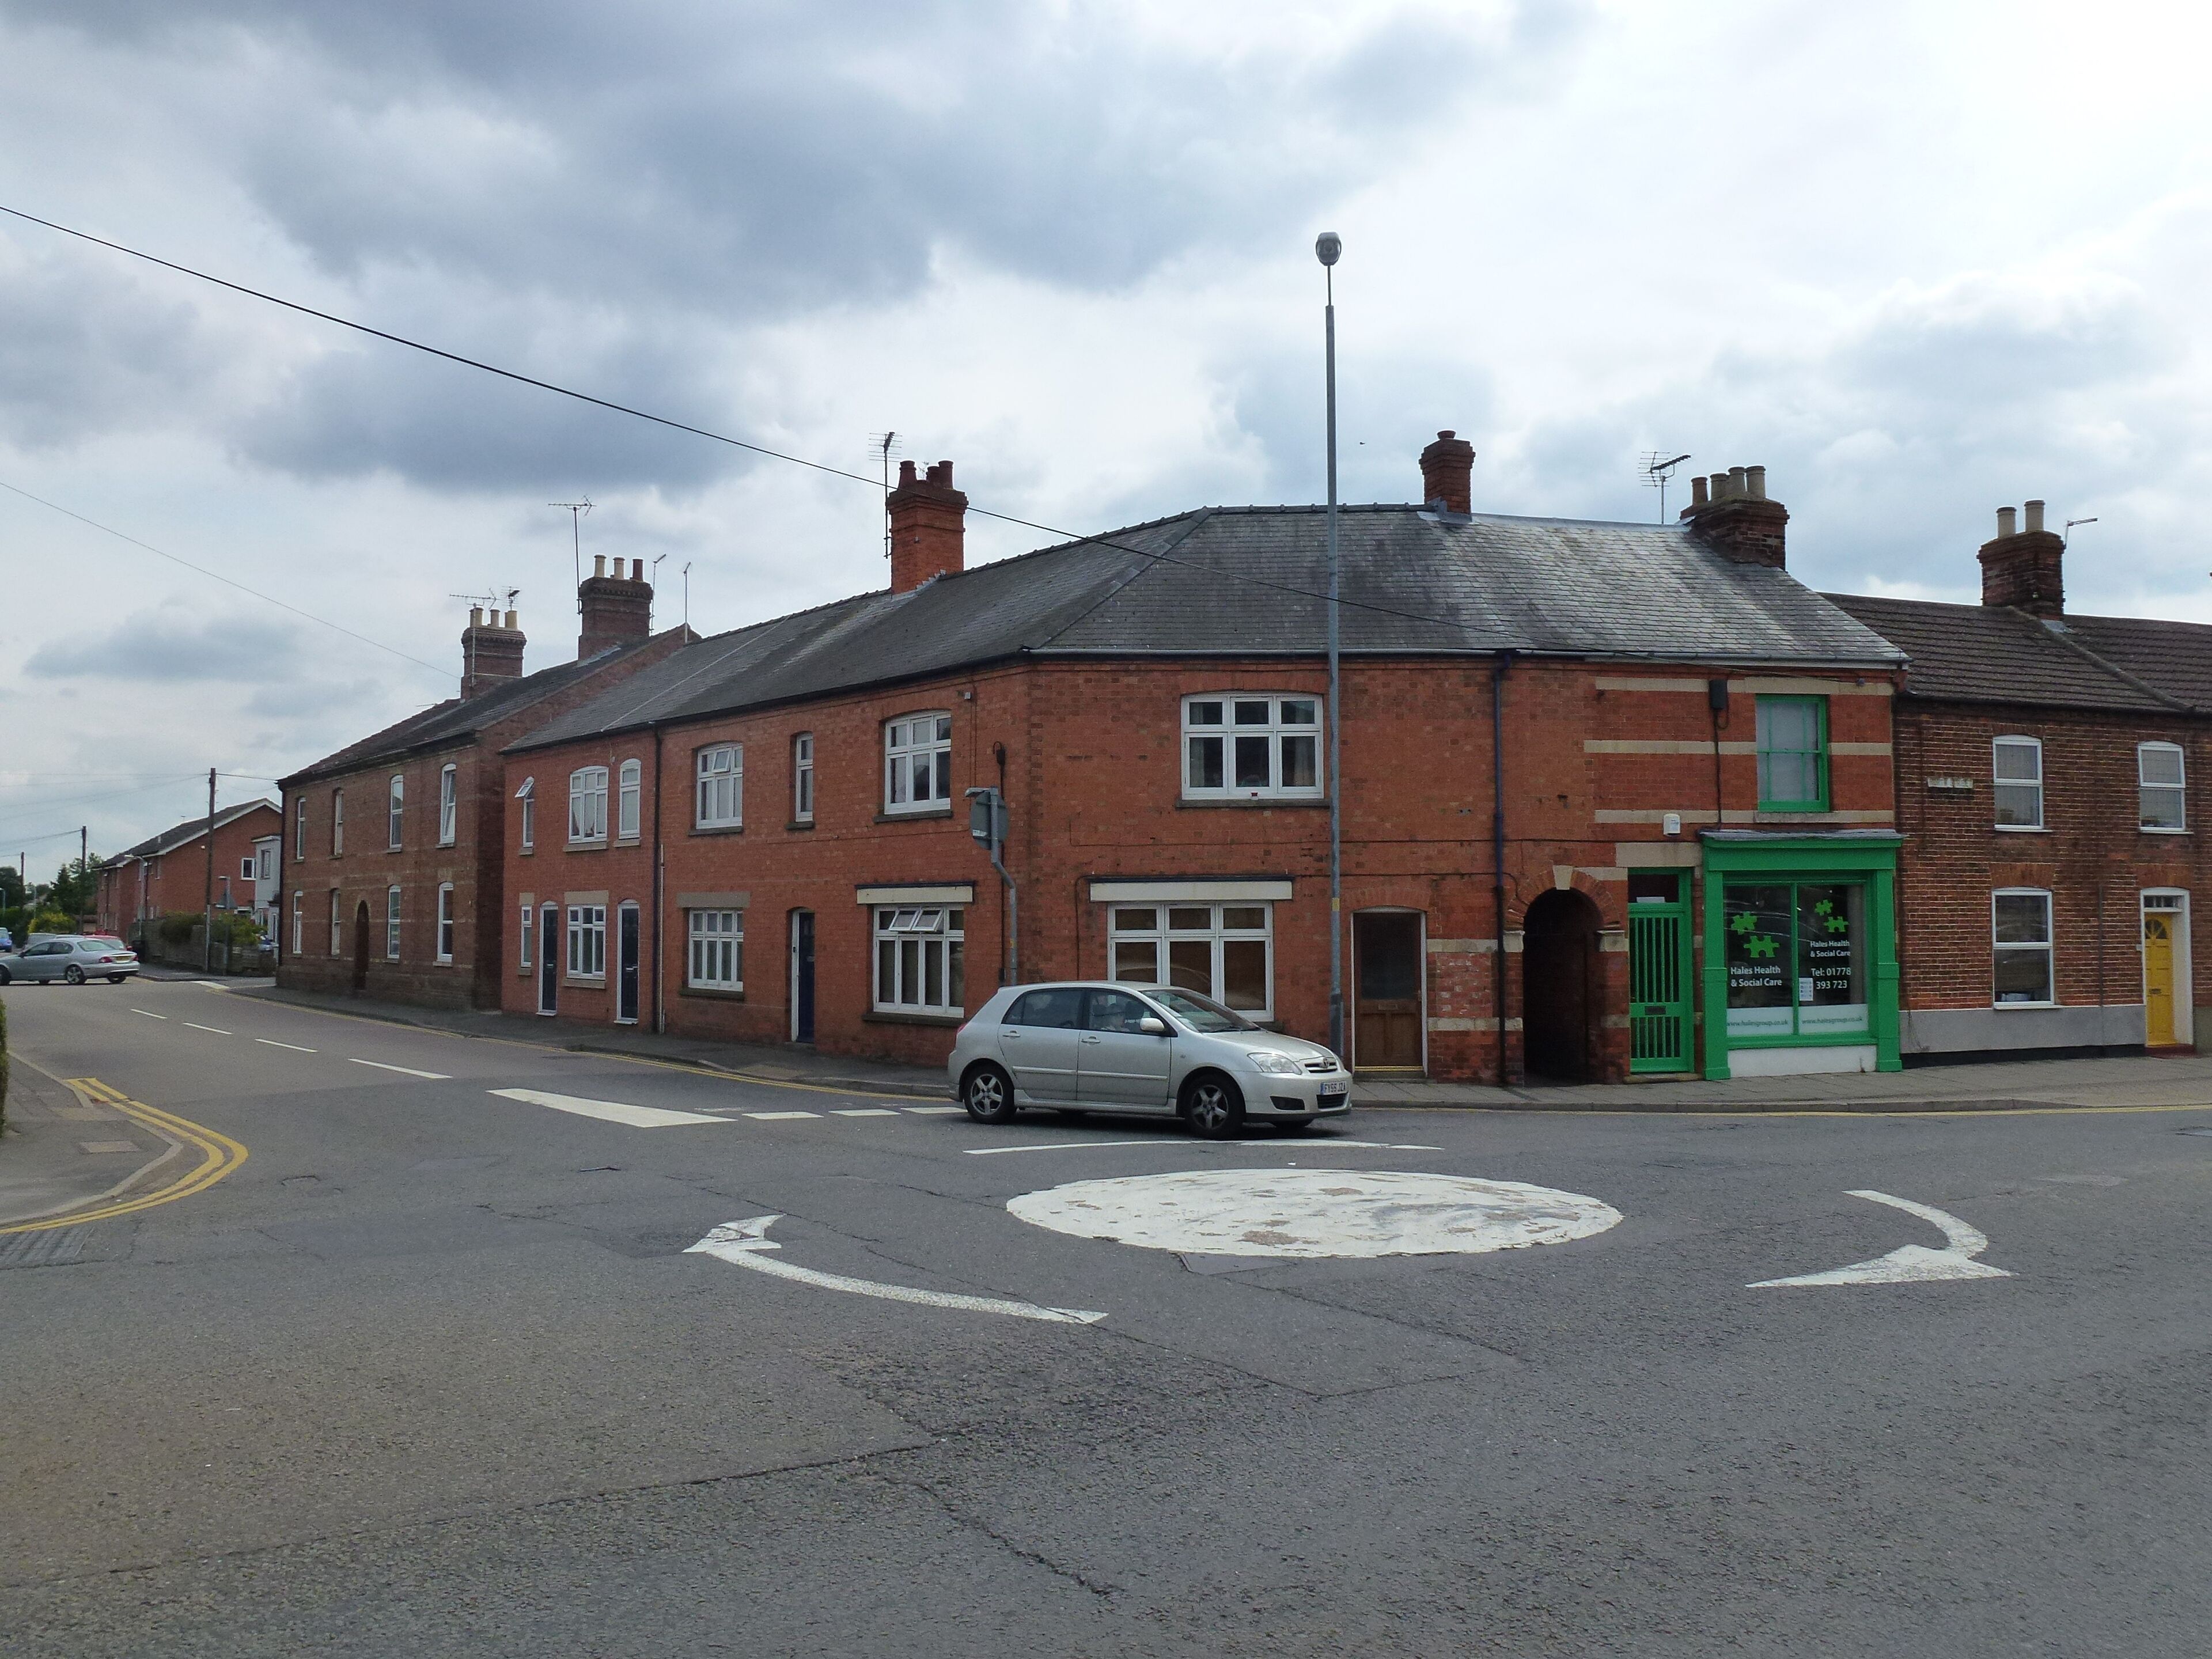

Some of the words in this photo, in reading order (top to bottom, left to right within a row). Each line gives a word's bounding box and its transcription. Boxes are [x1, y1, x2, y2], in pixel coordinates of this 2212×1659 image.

[1730, 967, 1753, 975] Hales
[1754, 965, 1781, 974] Health
[1811, 968, 1825, 976] Tel:
[1826, 967, 1852, 976] 01778
[1738, 978, 1763, 987] Social
[1764, 978, 1783, 986] Care
[1816, 981, 1831, 989] 393
[1832, 980, 1848, 988] 723
